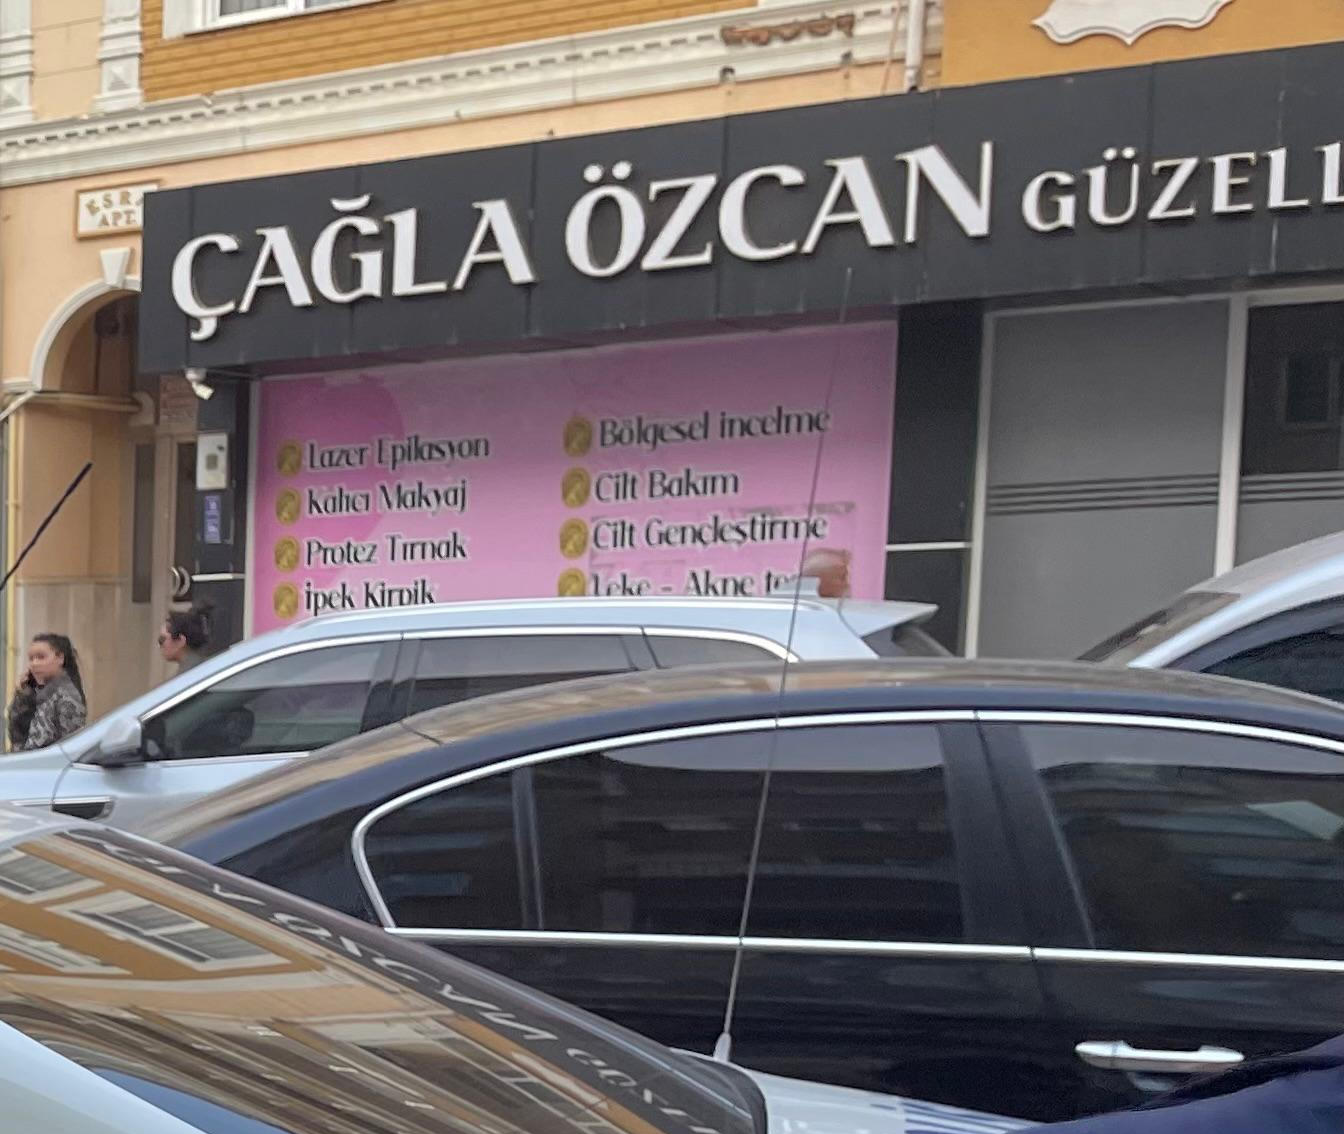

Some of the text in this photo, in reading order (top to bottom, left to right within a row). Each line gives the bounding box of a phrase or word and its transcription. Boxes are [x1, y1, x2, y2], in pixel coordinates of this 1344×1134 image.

[171, 193, 537, 341] ÇAĞLA
[565, 140, 994, 278] ÖZCAN
[599, 405, 830, 450] Bölgesel incelme
[308, 434, 490, 471] Lazer Epilasyon
[380, 480, 467, 516] Makyaj
[596, 468, 739, 502] Cilt Bakım
[593, 513, 828, 549] Cilt Gençleştirme
[306, 540, 378, 566] Protez
